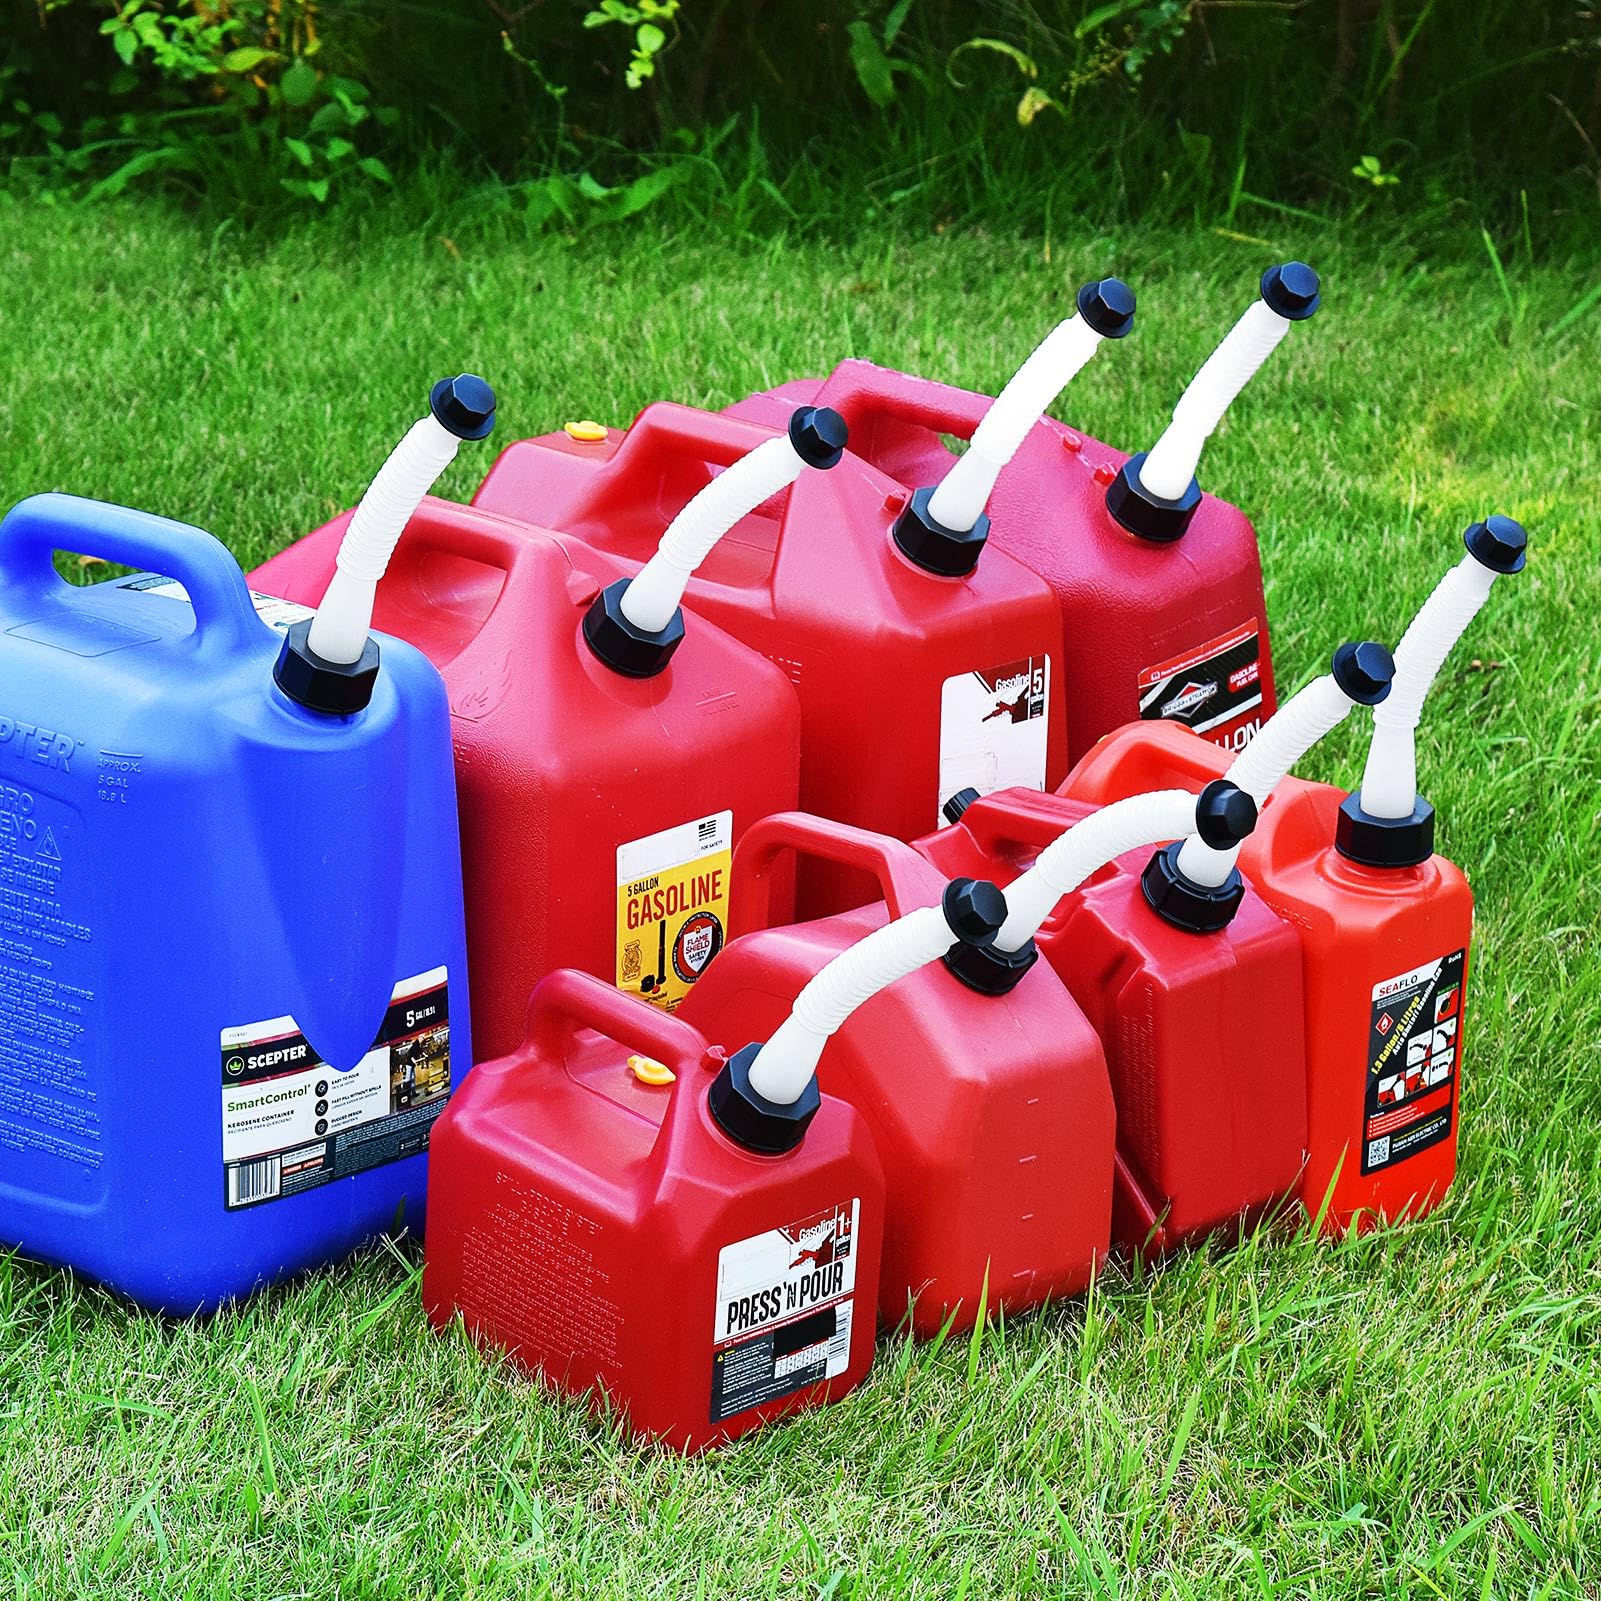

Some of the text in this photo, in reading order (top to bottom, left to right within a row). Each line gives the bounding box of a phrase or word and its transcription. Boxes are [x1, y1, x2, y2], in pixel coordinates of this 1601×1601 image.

[995, 673, 1030, 690] Gasoline
[1033, 668, 1043, 694] 5
[97, 757, 141, 772] APPROX.
[106, 776, 128, 788] GAL
[120, 793, 127, 804] L
[627, 876, 660, 897] 5 GALLON
[627, 869, 723, 930] GASOLINE
[685, 940, 710, 955] SHIELD
[687, 933, 708, 945] FLAME
[689, 950, 706, 960] SAFETY
[1379, 975, 1418, 997] SEAFLO
[406, 1010, 415, 1027] 5
[1393, 1037, 1406, 1056] Auto
[1417, 981, 1436, 1011] Gasoline
[1432, 967, 1443, 982] Can
[247, 1044, 307, 1070] SCEPTER
[227, 1085, 307, 1112] SmartControl
[227, 1109, 295, 1128] KEROSENE CONTAINER
[799, 1219, 836, 1241] Gasoline
[727, 1285, 782, 1335] PRESS
[783, 1281, 797, 1310] 'N
[799, 1260, 844, 1308] POUR
